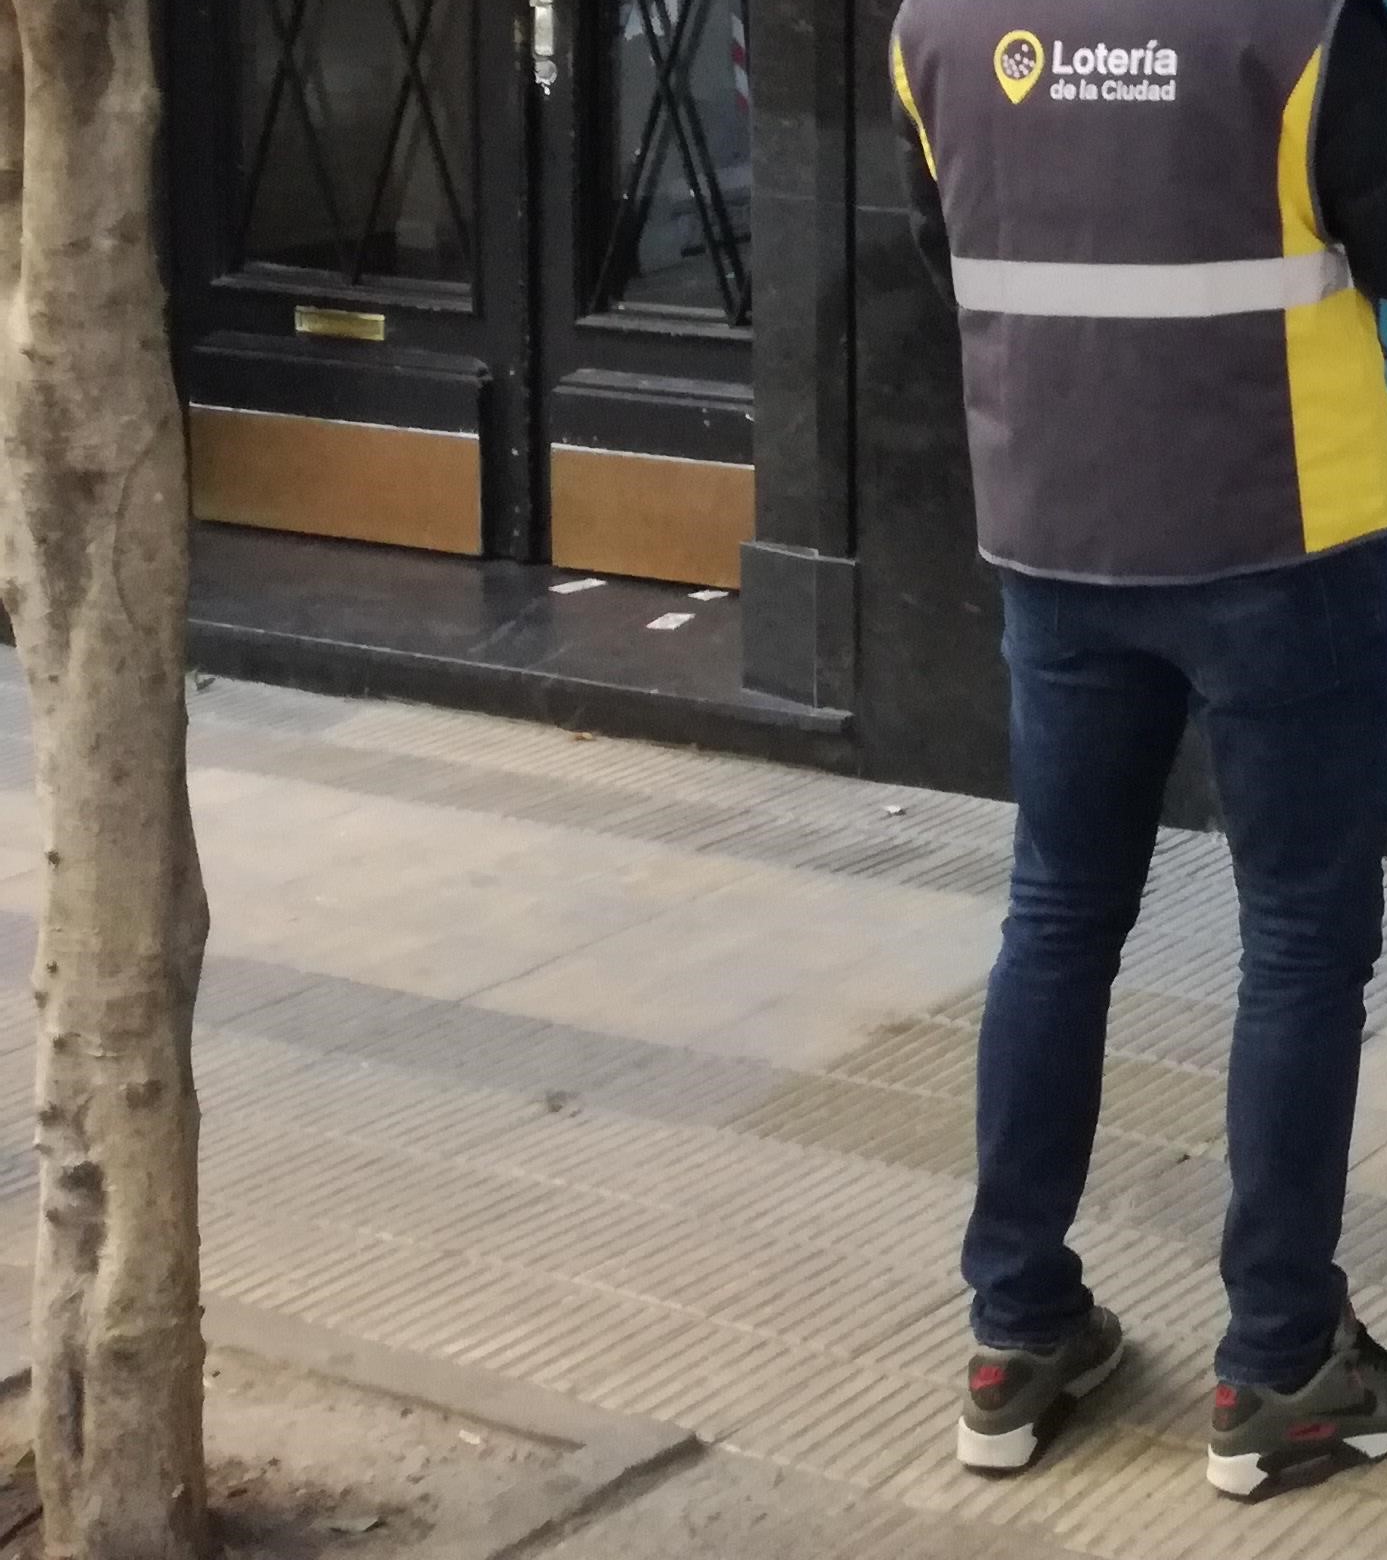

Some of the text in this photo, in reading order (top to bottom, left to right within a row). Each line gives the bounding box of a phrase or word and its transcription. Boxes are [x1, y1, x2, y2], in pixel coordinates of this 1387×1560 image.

[1052, 39, 1178, 76] Lotería
[1050, 78, 1177, 101] de la Ciudad
